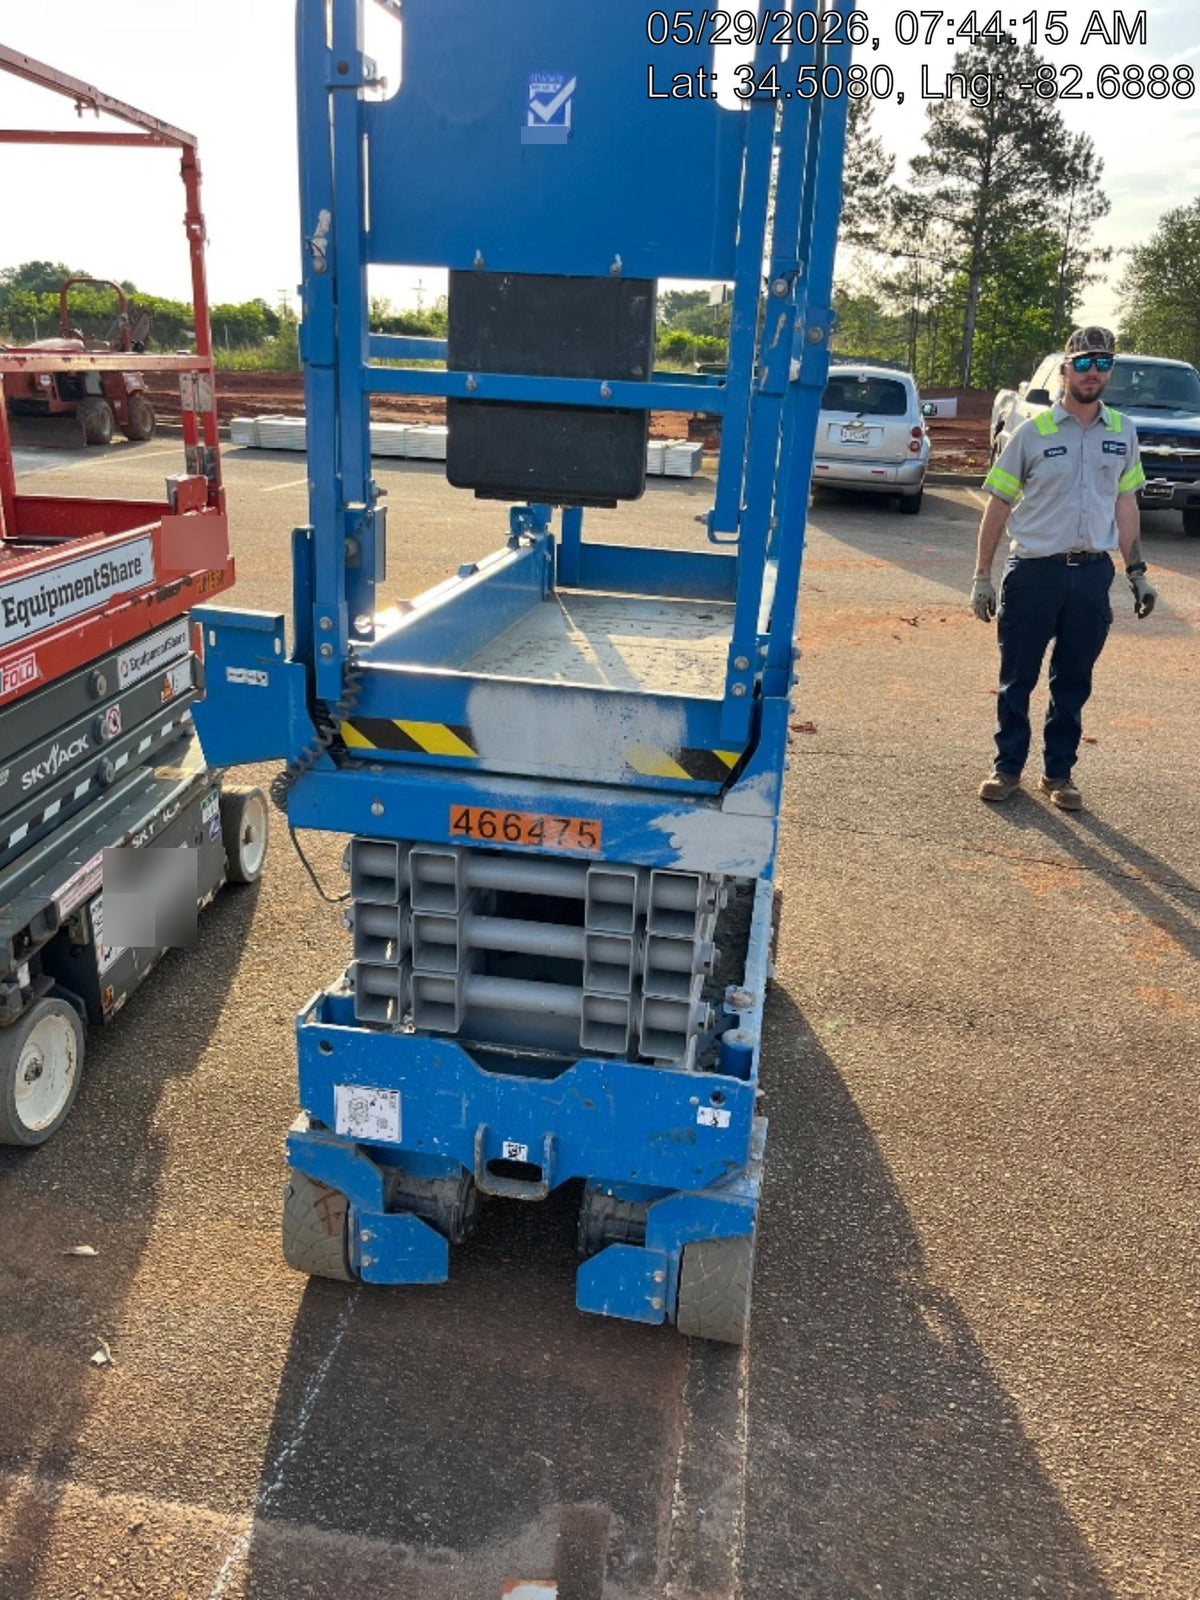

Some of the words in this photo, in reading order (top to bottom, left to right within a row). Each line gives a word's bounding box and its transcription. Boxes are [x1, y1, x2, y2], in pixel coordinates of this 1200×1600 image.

[1, 556, 143, 628] EquipmentShare
[21, 733, 90, 791] SKYJACK
[452, 808, 598, 850] 466475
